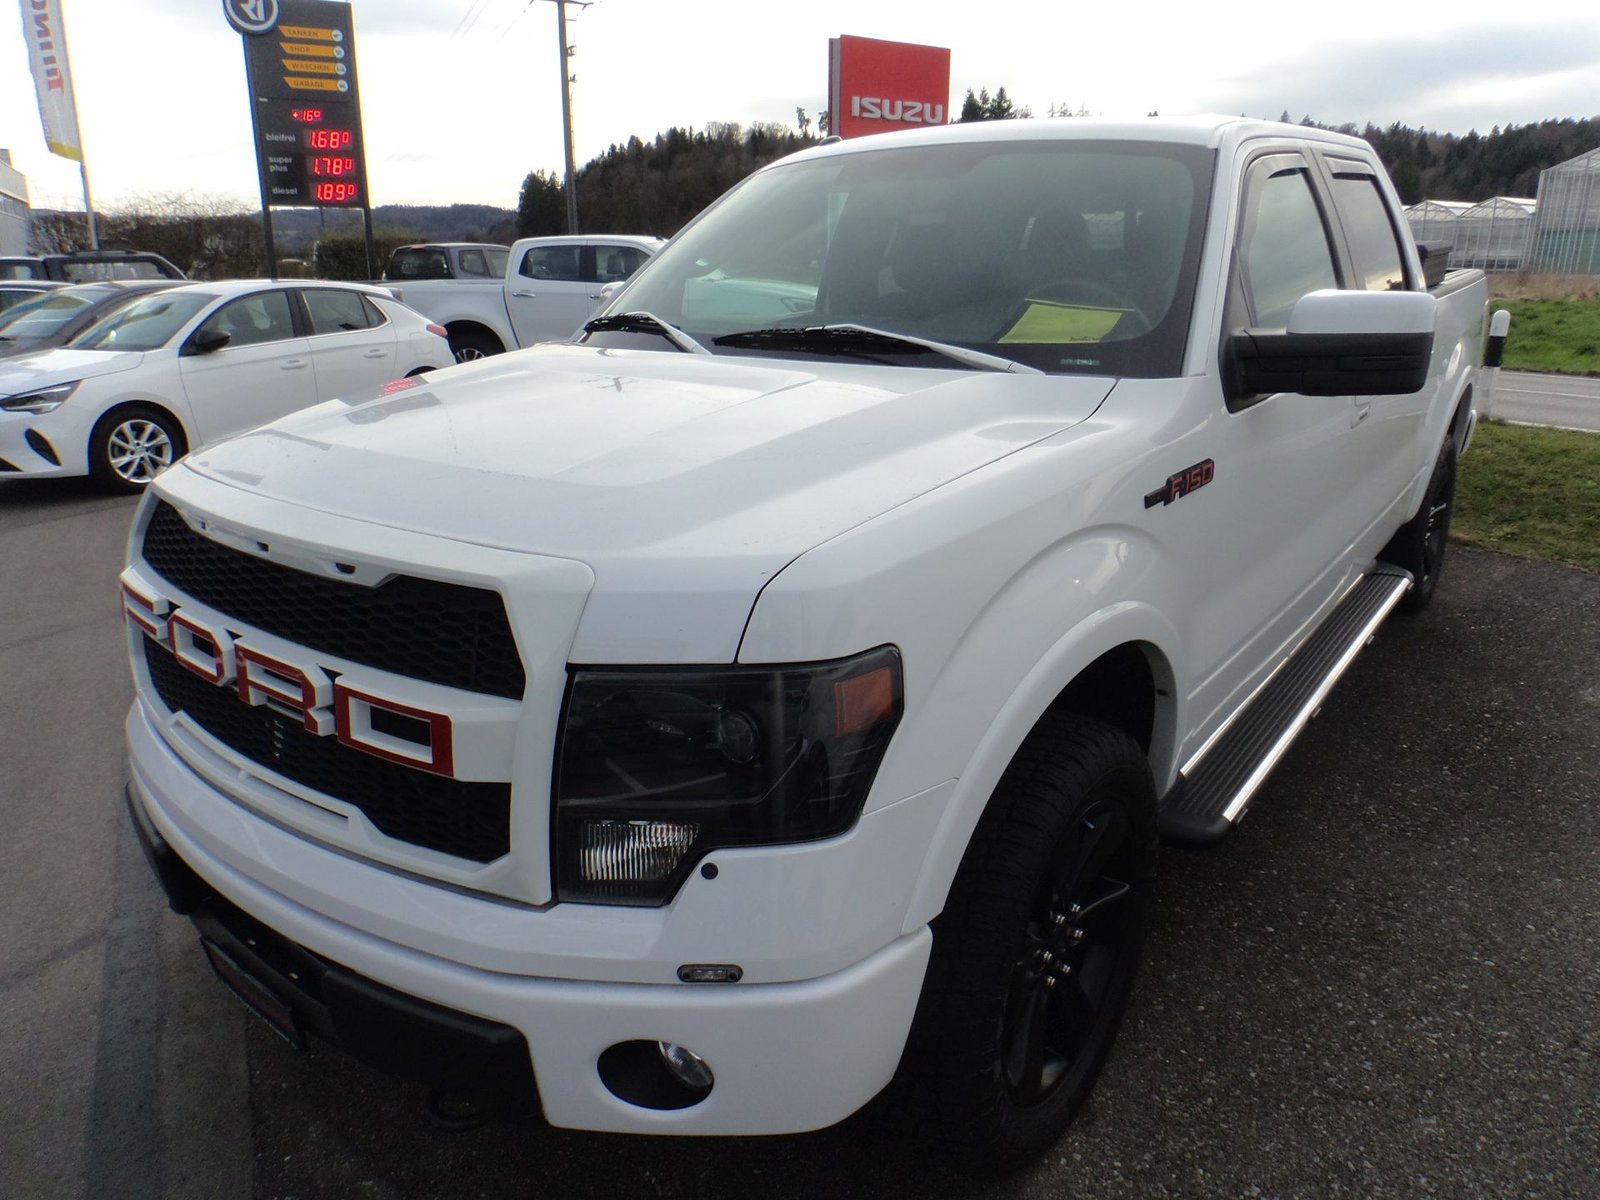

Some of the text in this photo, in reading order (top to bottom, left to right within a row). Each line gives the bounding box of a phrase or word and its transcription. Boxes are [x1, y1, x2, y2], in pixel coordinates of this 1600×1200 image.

[288, 29, 318, 37] TANKEN
[292, 63, 329, 71] WASCHEN
[294, 80, 324, 88] GARAGE
[851, 95, 943, 124] ISUZU
[265, 132, 296, 142] bleifrei
[268, 156, 293, 165] super
[270, 163, 288, 173] plus
[272, 186, 298, 195] diesel
